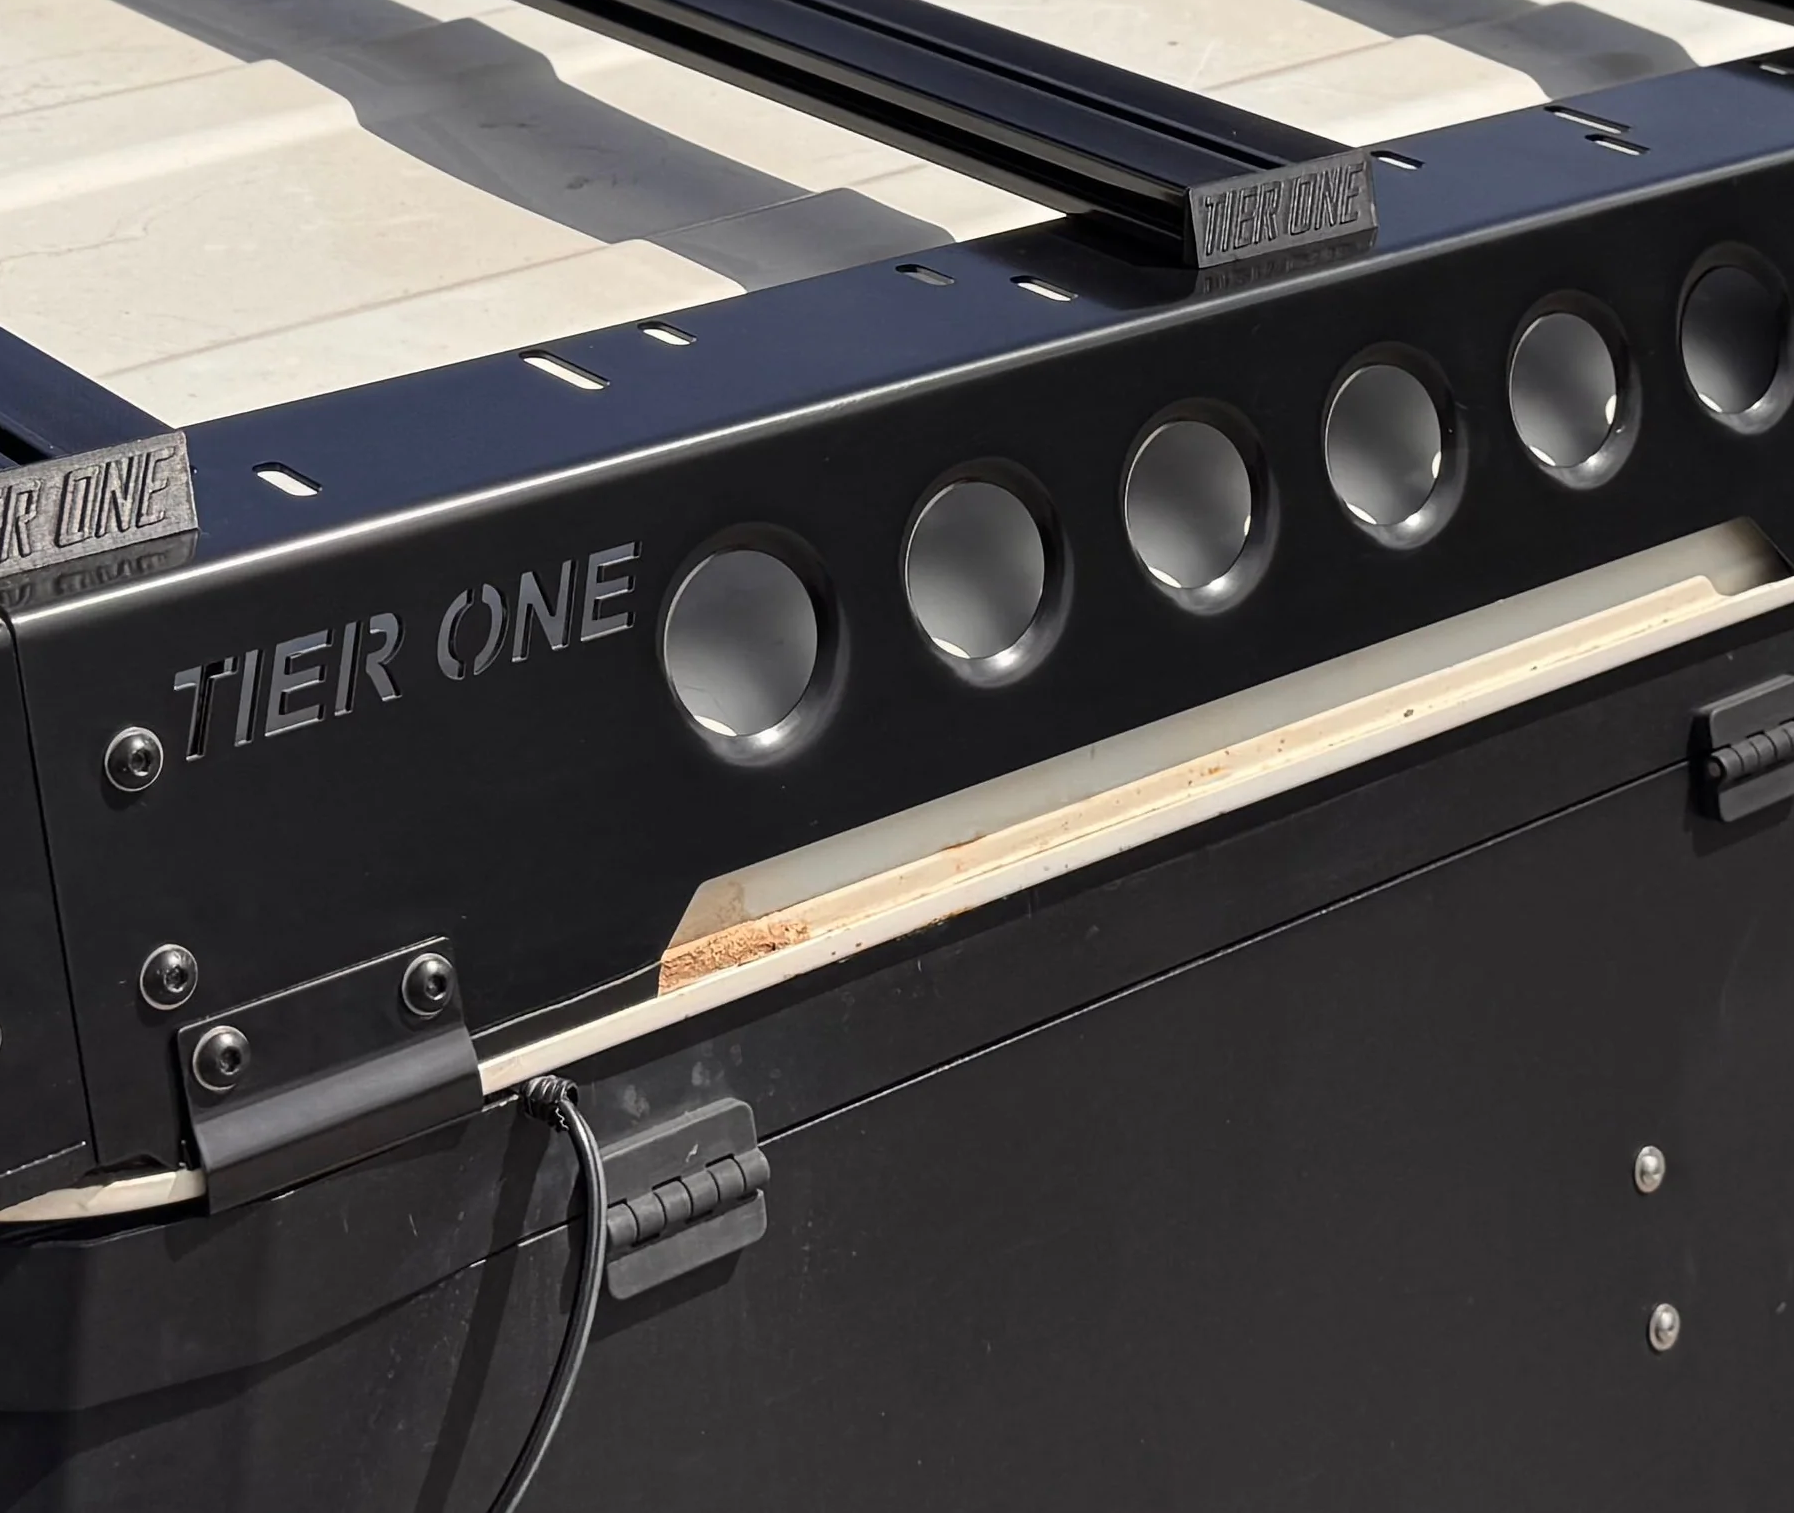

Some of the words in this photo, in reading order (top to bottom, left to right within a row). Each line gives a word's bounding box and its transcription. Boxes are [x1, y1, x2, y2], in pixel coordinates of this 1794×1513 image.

[1202, 180, 1284, 256] TIER
[1288, 160, 1367, 236] ONE
[54, 444, 177, 549] ONE
[173, 611, 405, 762] TIER
[436, 541, 643, 681] ONE
